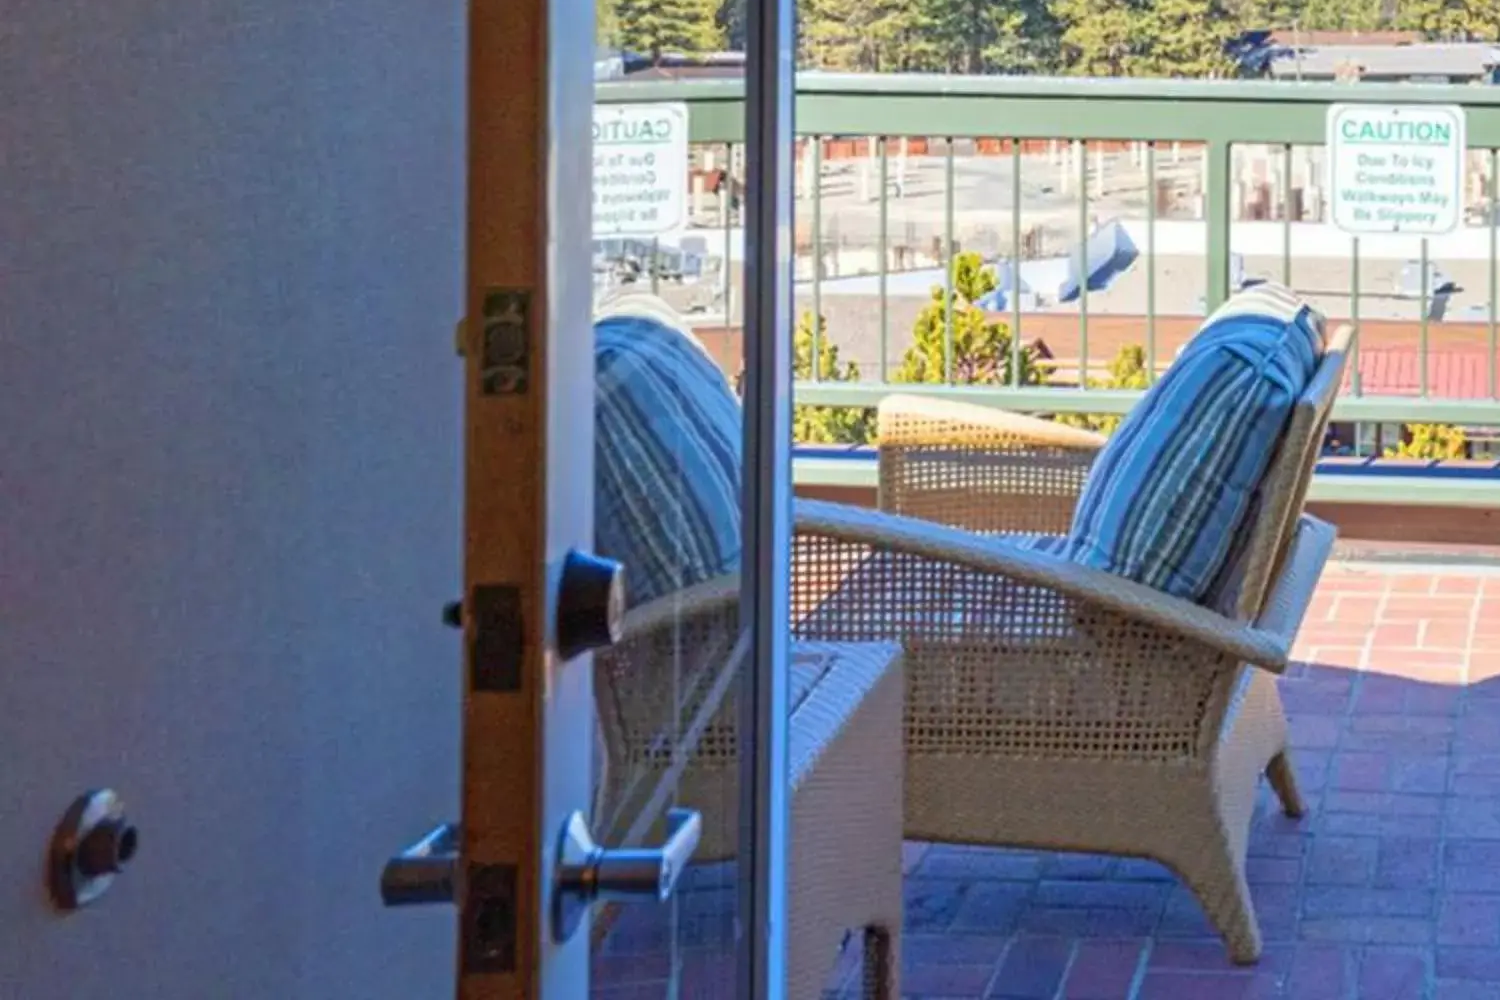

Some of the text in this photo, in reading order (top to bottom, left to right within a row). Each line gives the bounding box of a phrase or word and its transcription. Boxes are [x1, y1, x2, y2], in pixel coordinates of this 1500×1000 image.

[1342, 119, 1451, 140] CAUTION
[1357, 153, 1387, 167] Due
[1392, 153, 1409, 168] To
[1355, 171, 1436, 187] Conditions
[1341, 188, 1450, 208] Walkways May
[1353, 206, 1437, 227] Be Slippery
